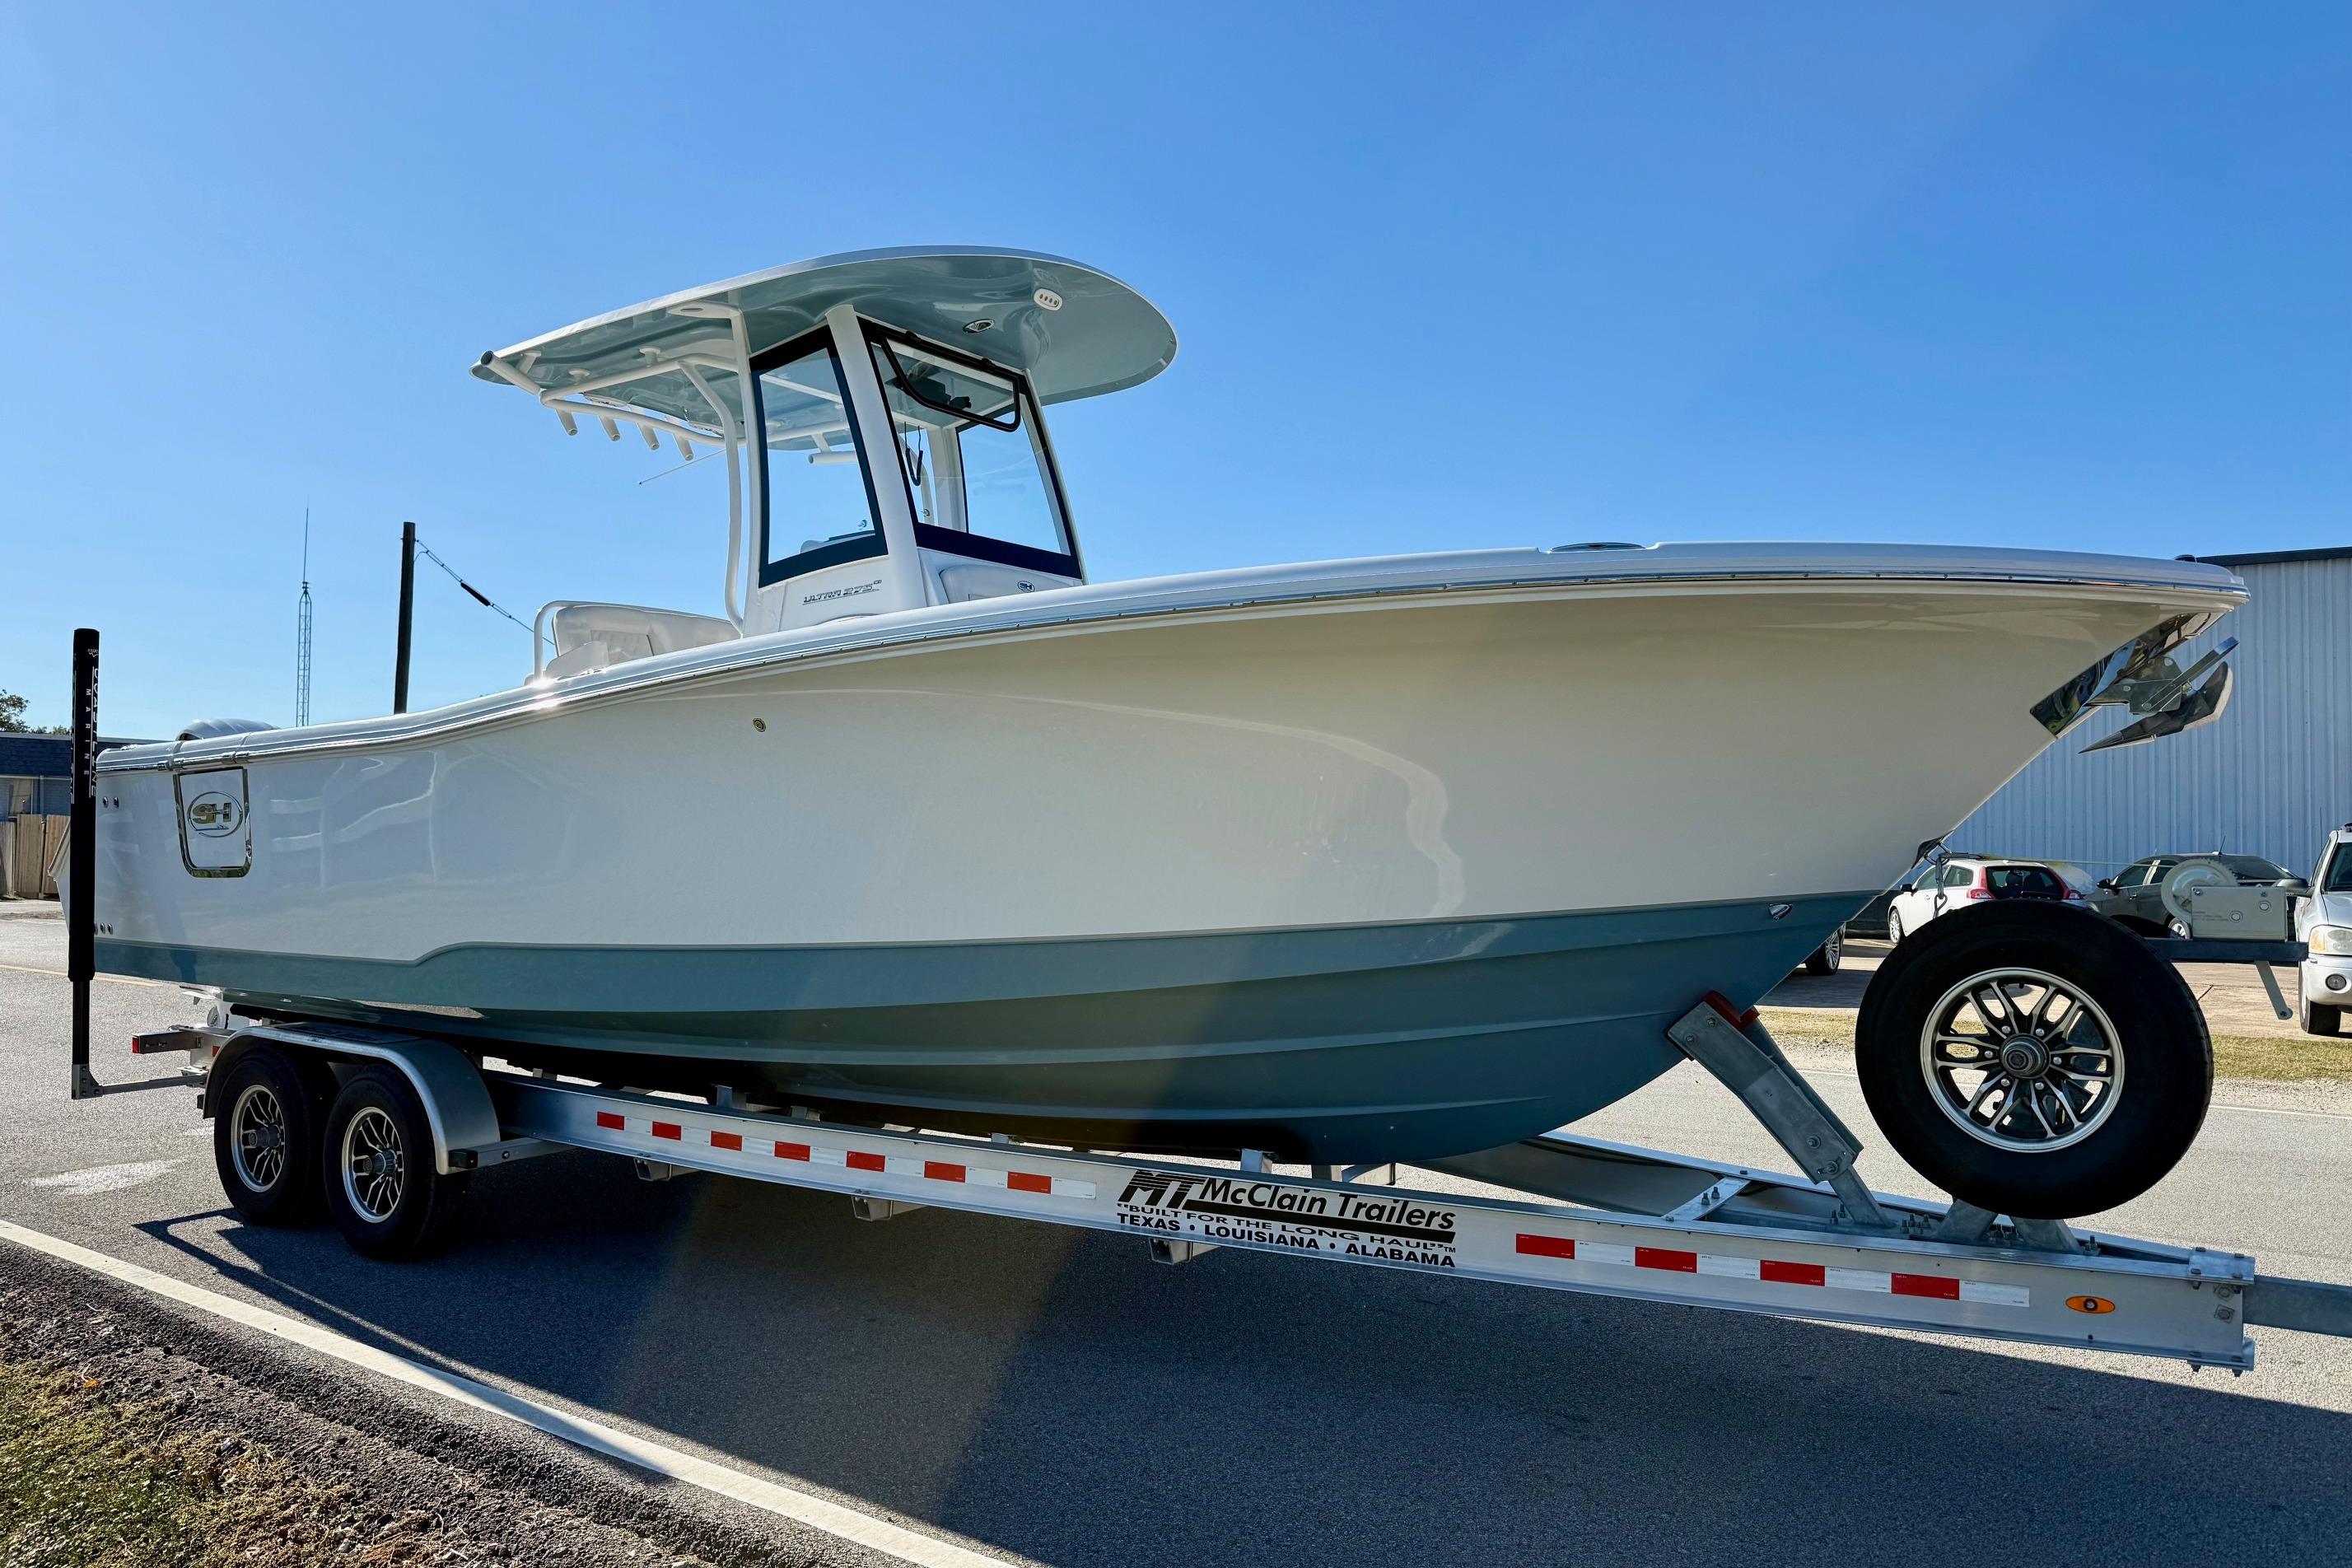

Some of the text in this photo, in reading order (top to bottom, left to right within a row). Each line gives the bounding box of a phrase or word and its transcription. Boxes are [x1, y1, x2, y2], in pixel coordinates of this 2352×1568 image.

[1118, 1169, 1207, 1210] MT
[1199, 1177, 1457, 1230] McClain Trailers
[1117, 1213, 1456, 1268] TEXAS LOUISIANA ALABAMA
[1187, 1212, 1228, 1224] FOR
[1234, 1219, 1272, 1230] THE
[1281, 1225, 1360, 1241] LONG
